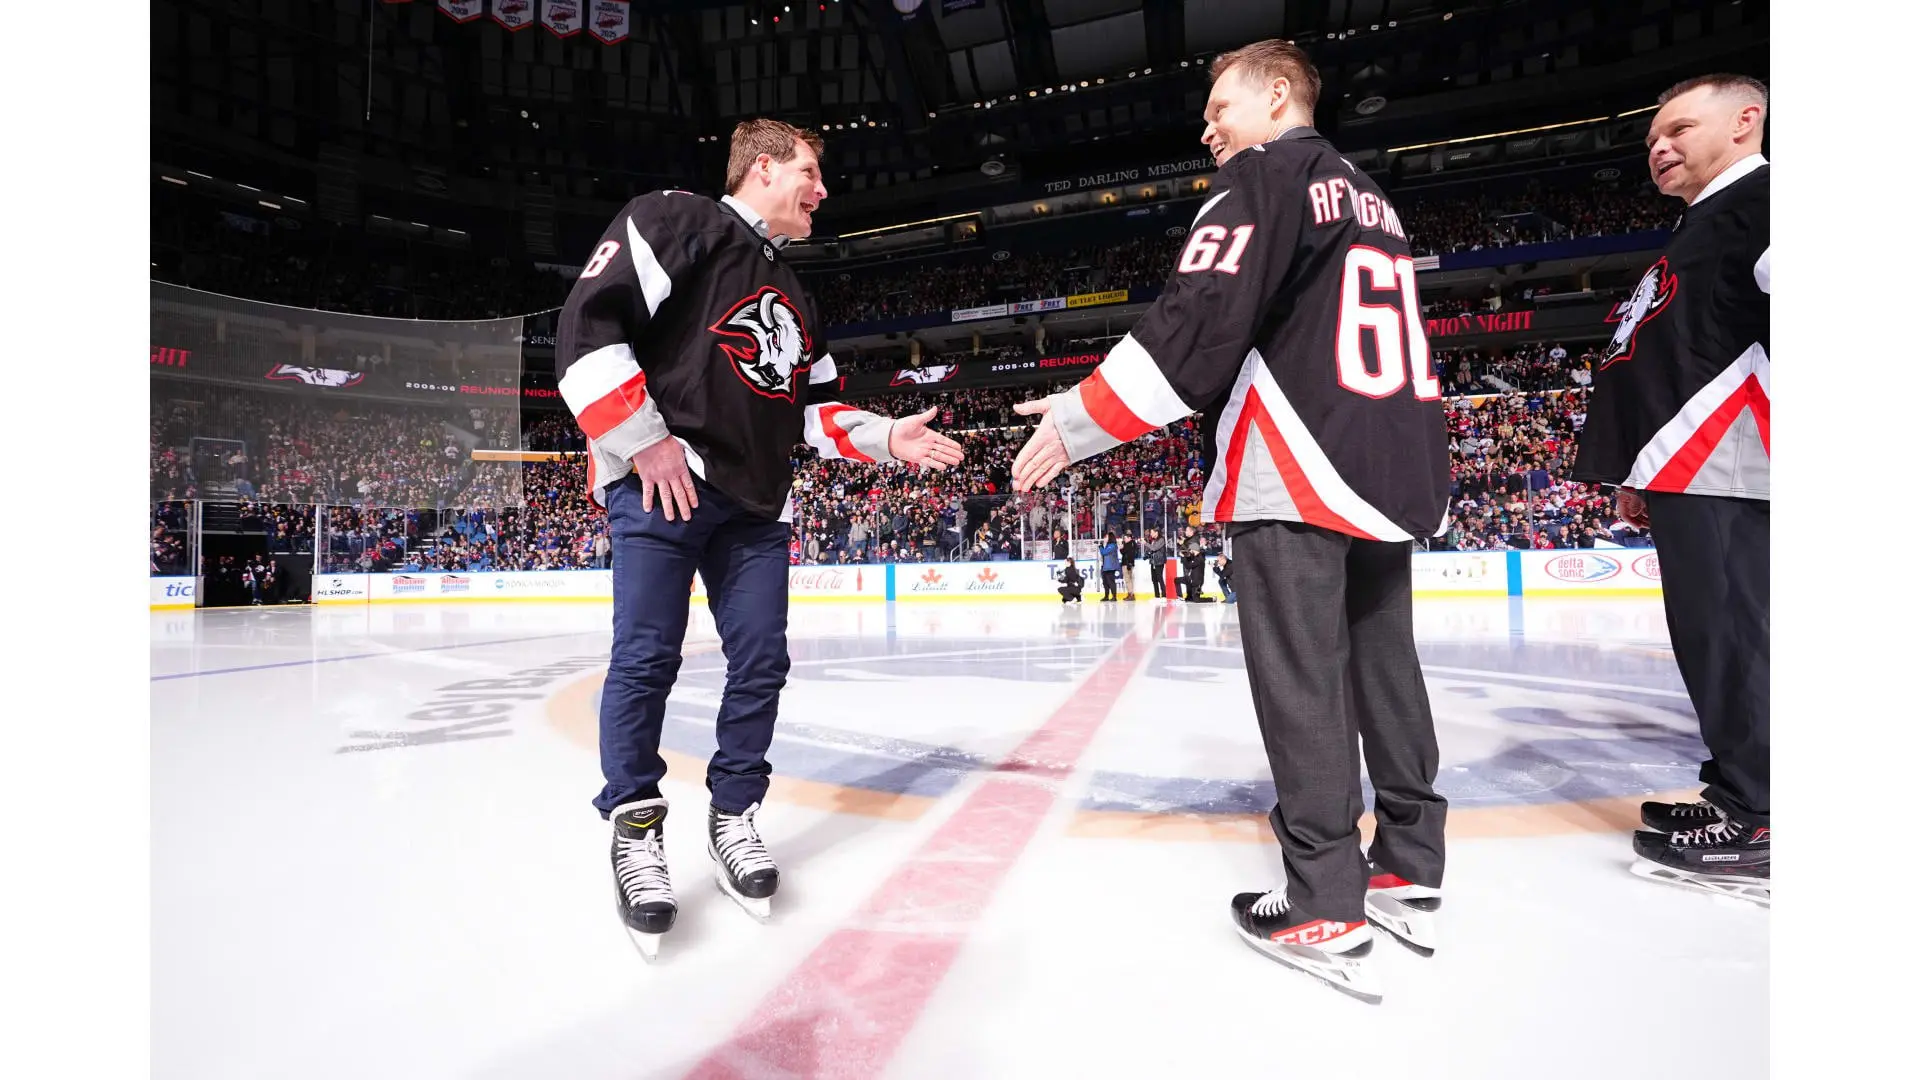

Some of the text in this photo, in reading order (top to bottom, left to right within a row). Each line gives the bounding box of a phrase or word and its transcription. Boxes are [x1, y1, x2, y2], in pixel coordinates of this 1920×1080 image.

[1045, 156, 1217, 193] TED DARLING MEMORIA
[1177, 224, 1255, 275] 61
[1335, 244, 1442, 401] 61
[1477, 311, 1535, 333] NIGHT
[532, 335, 557, 346] SENE
[991, 361, 1036, 371] 2005-06
[1039, 354, 1099, 368] REUNION
[405, 382, 456, 392] 2005-06
[459, 385, 519, 396] REUNION
[1557, 557, 1584, 568] delta
[1558, 568, 1585, 578] sonic
[166, 582, 195, 597] tic
[1271, 921, 1347, 945] CCM
